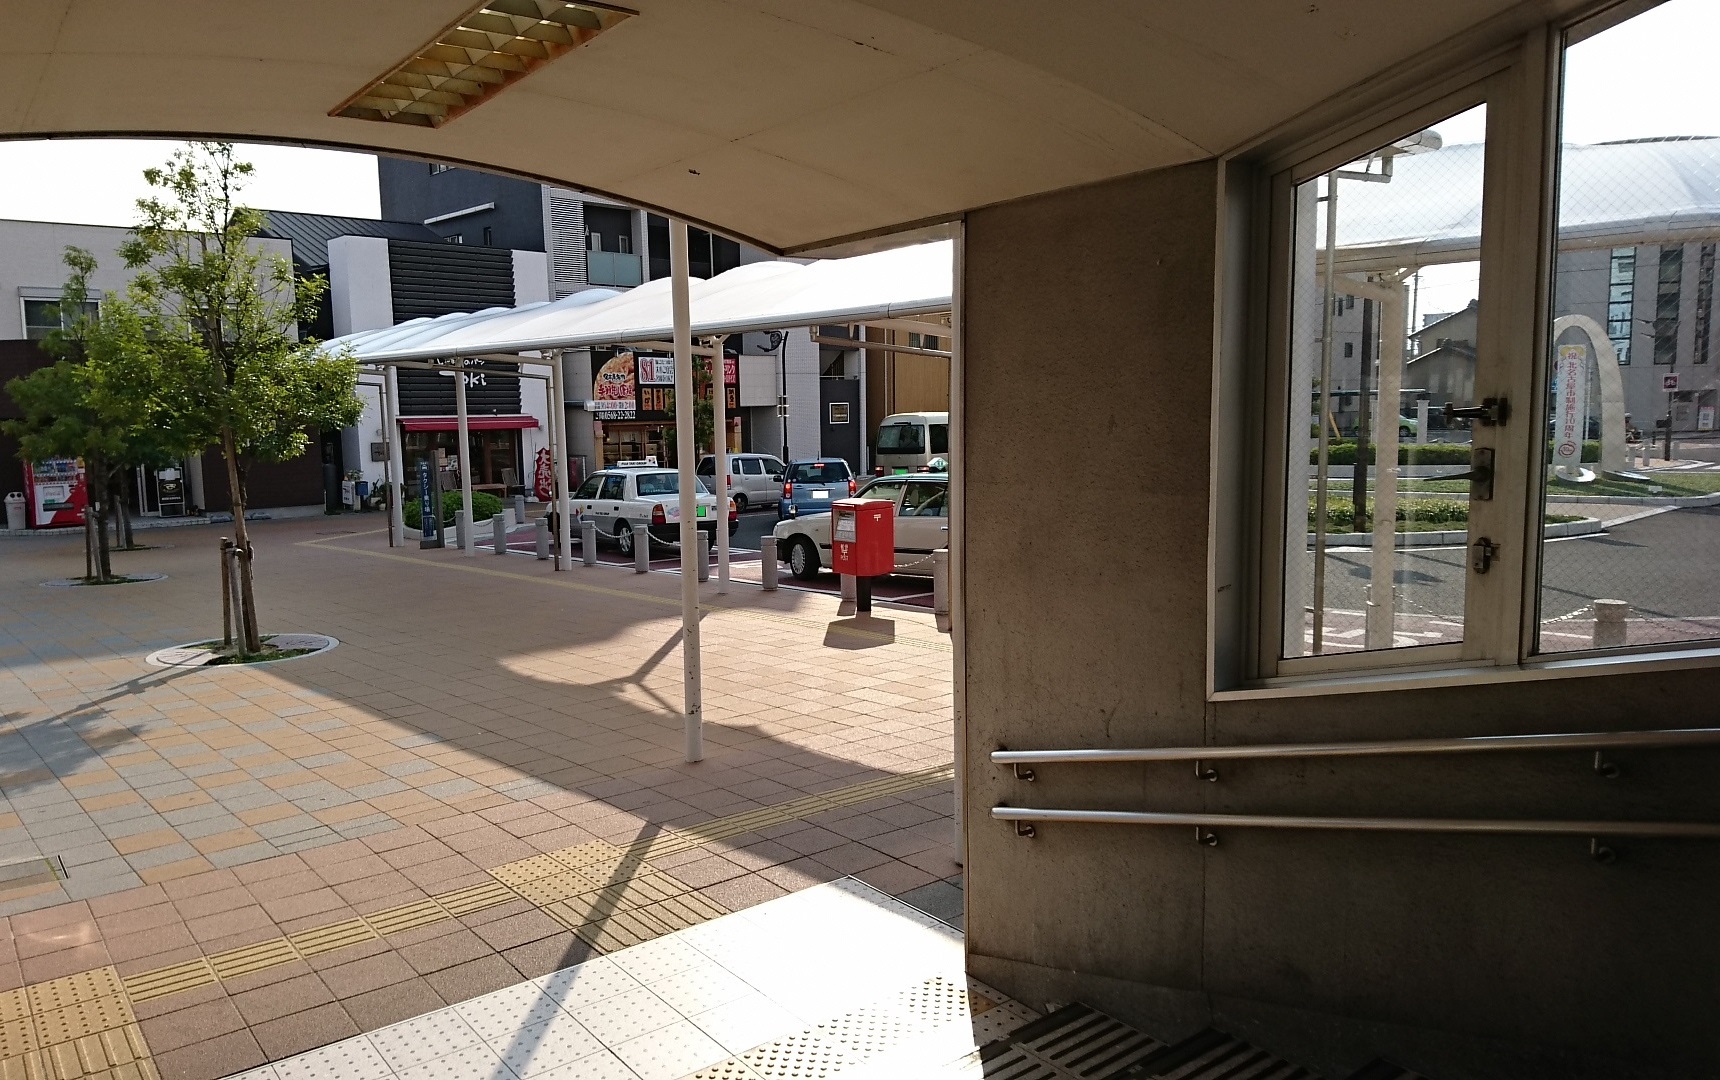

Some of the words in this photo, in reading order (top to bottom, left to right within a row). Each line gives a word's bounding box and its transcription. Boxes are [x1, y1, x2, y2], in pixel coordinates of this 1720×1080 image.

[422, 472, 431, 513] タクシー乗り場
